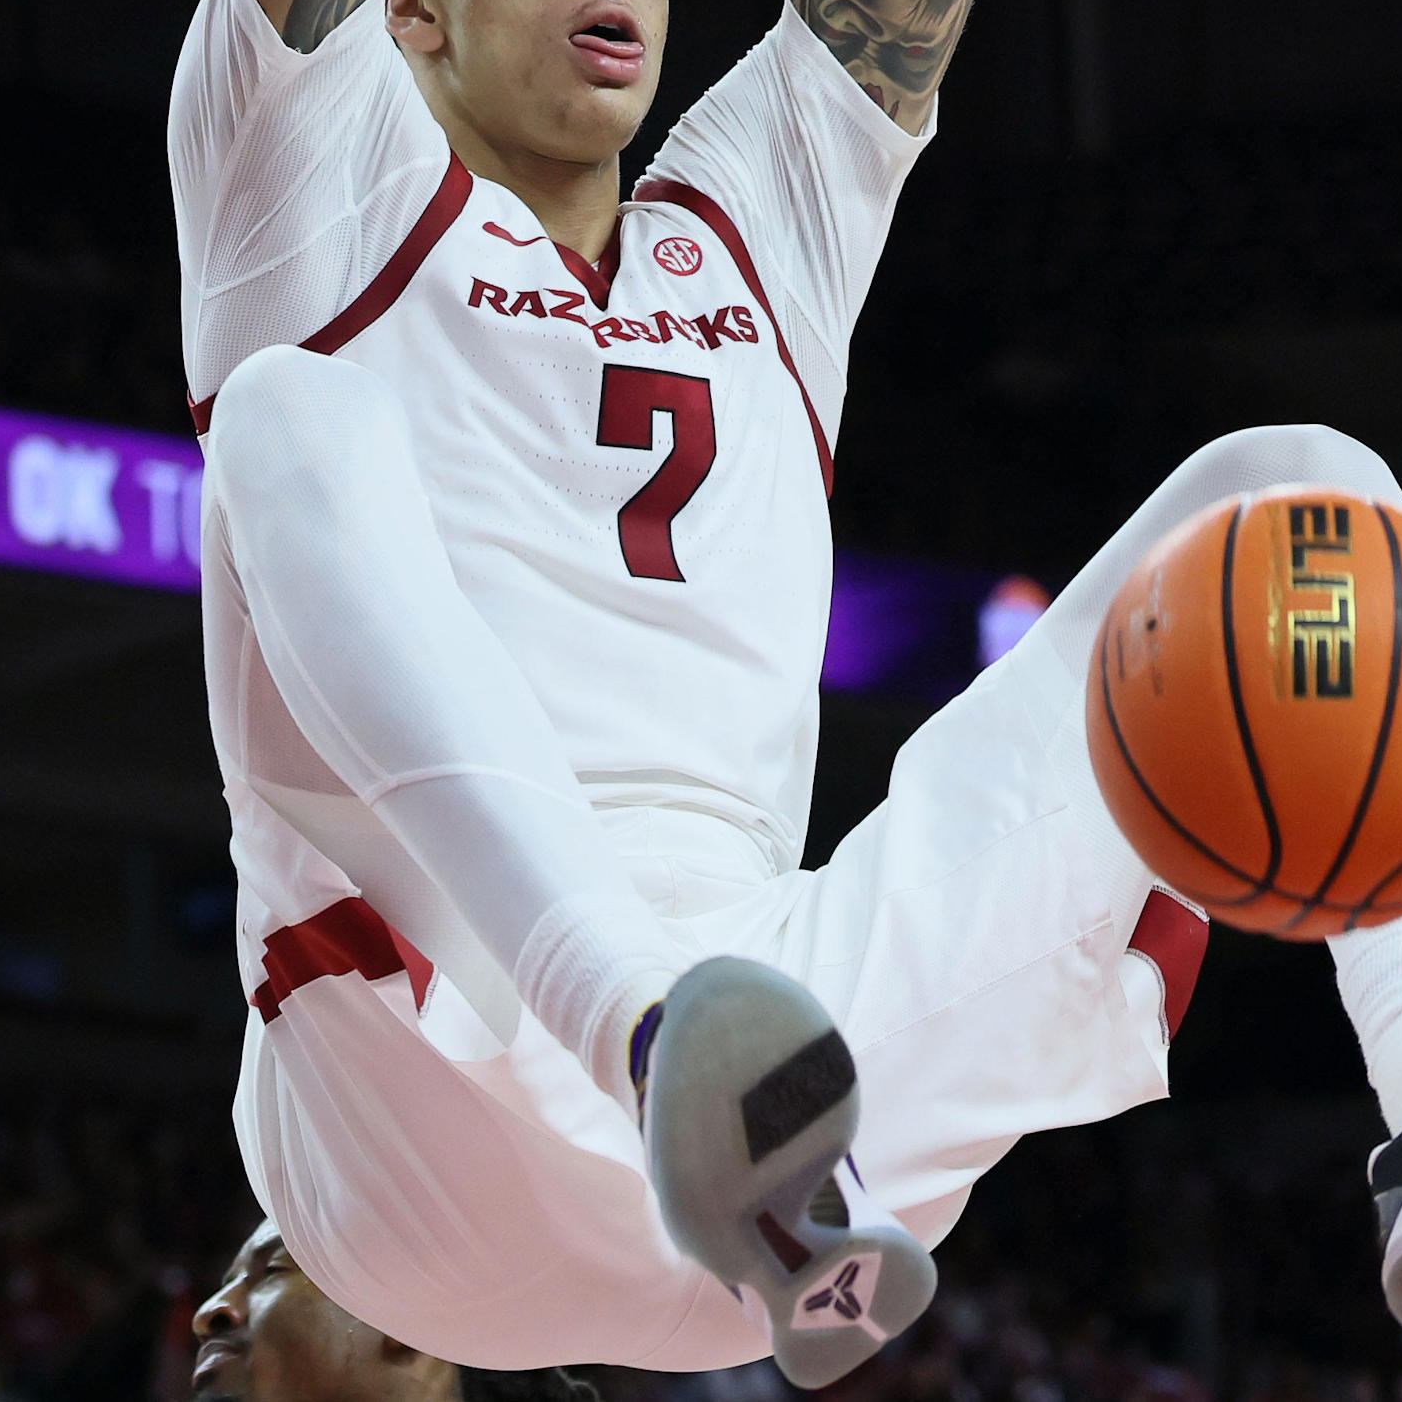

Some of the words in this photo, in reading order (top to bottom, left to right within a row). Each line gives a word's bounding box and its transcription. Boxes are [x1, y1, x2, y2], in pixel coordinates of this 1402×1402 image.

[655, 238, 702, 275] SEC
[6, 434, 121, 555] OK
[596, 363, 716, 583] 7
